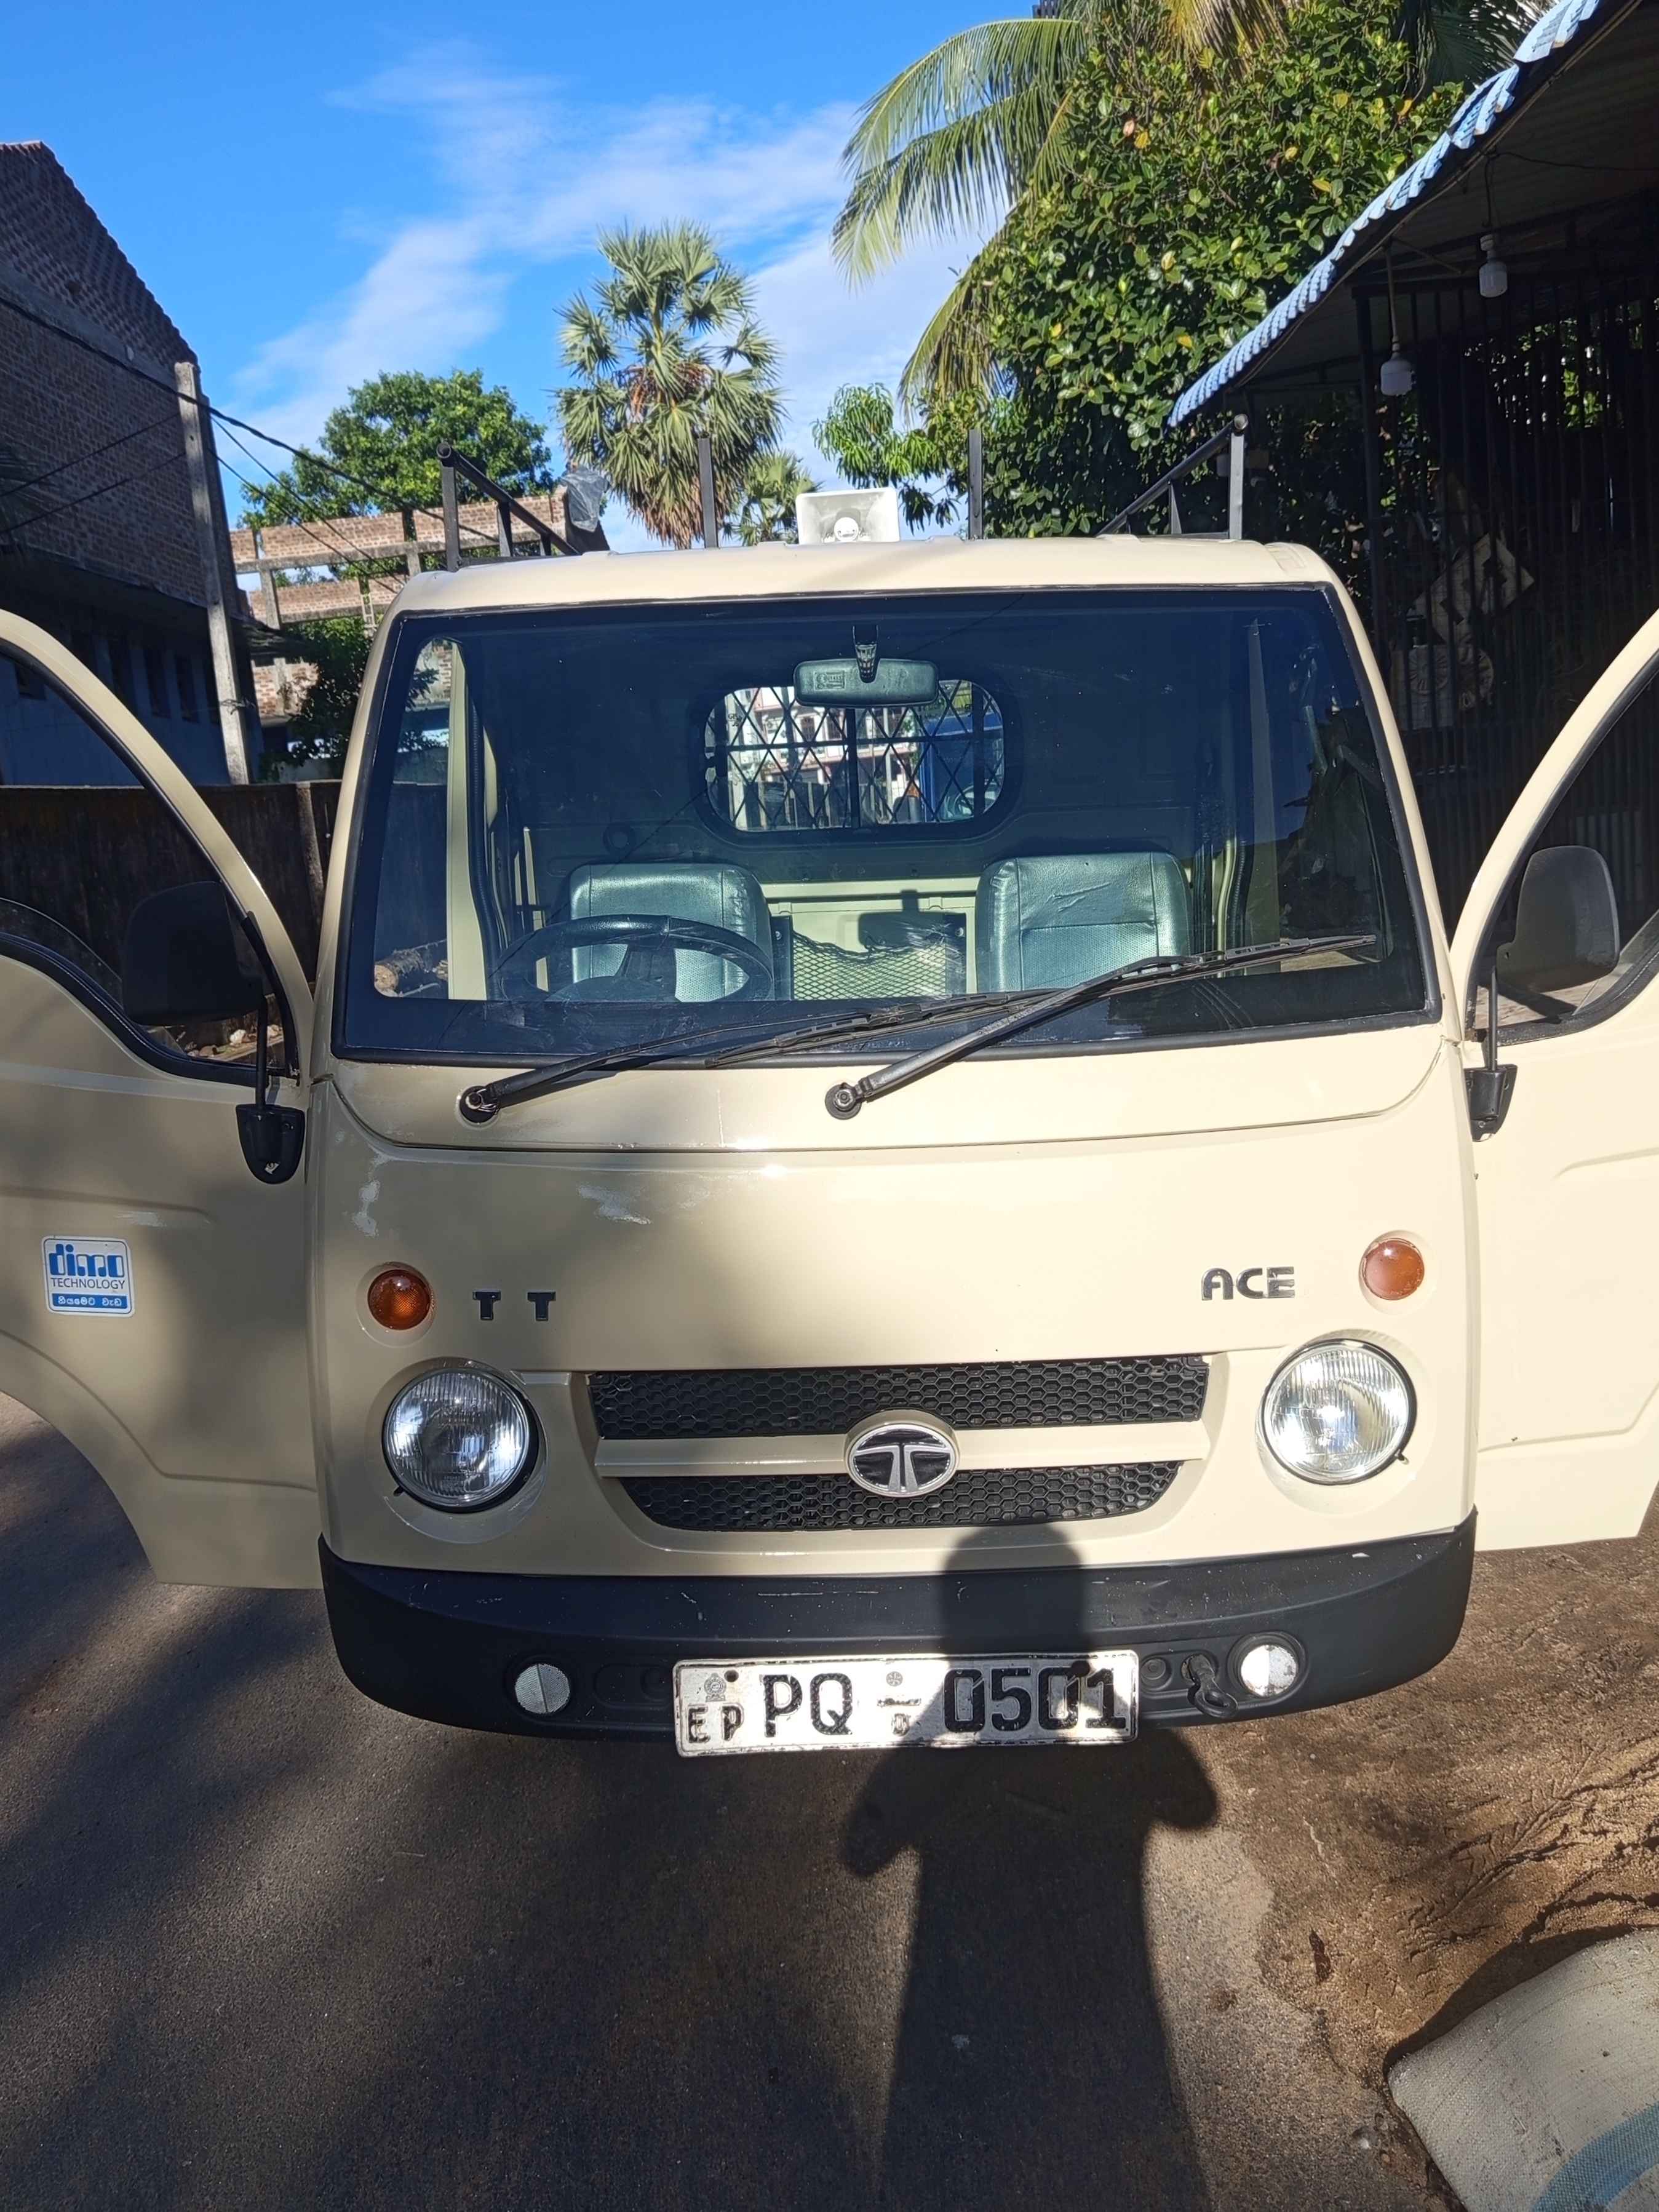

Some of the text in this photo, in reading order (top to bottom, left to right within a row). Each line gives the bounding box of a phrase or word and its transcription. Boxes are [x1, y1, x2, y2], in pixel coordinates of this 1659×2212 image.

[50, 1278, 125, 1289] TECHNOLOGY
[1201, 1266, 1295, 1301] ACE
[759, 1673, 853, 1738] PQ
[944, 1665, 1127, 1732] 0501
